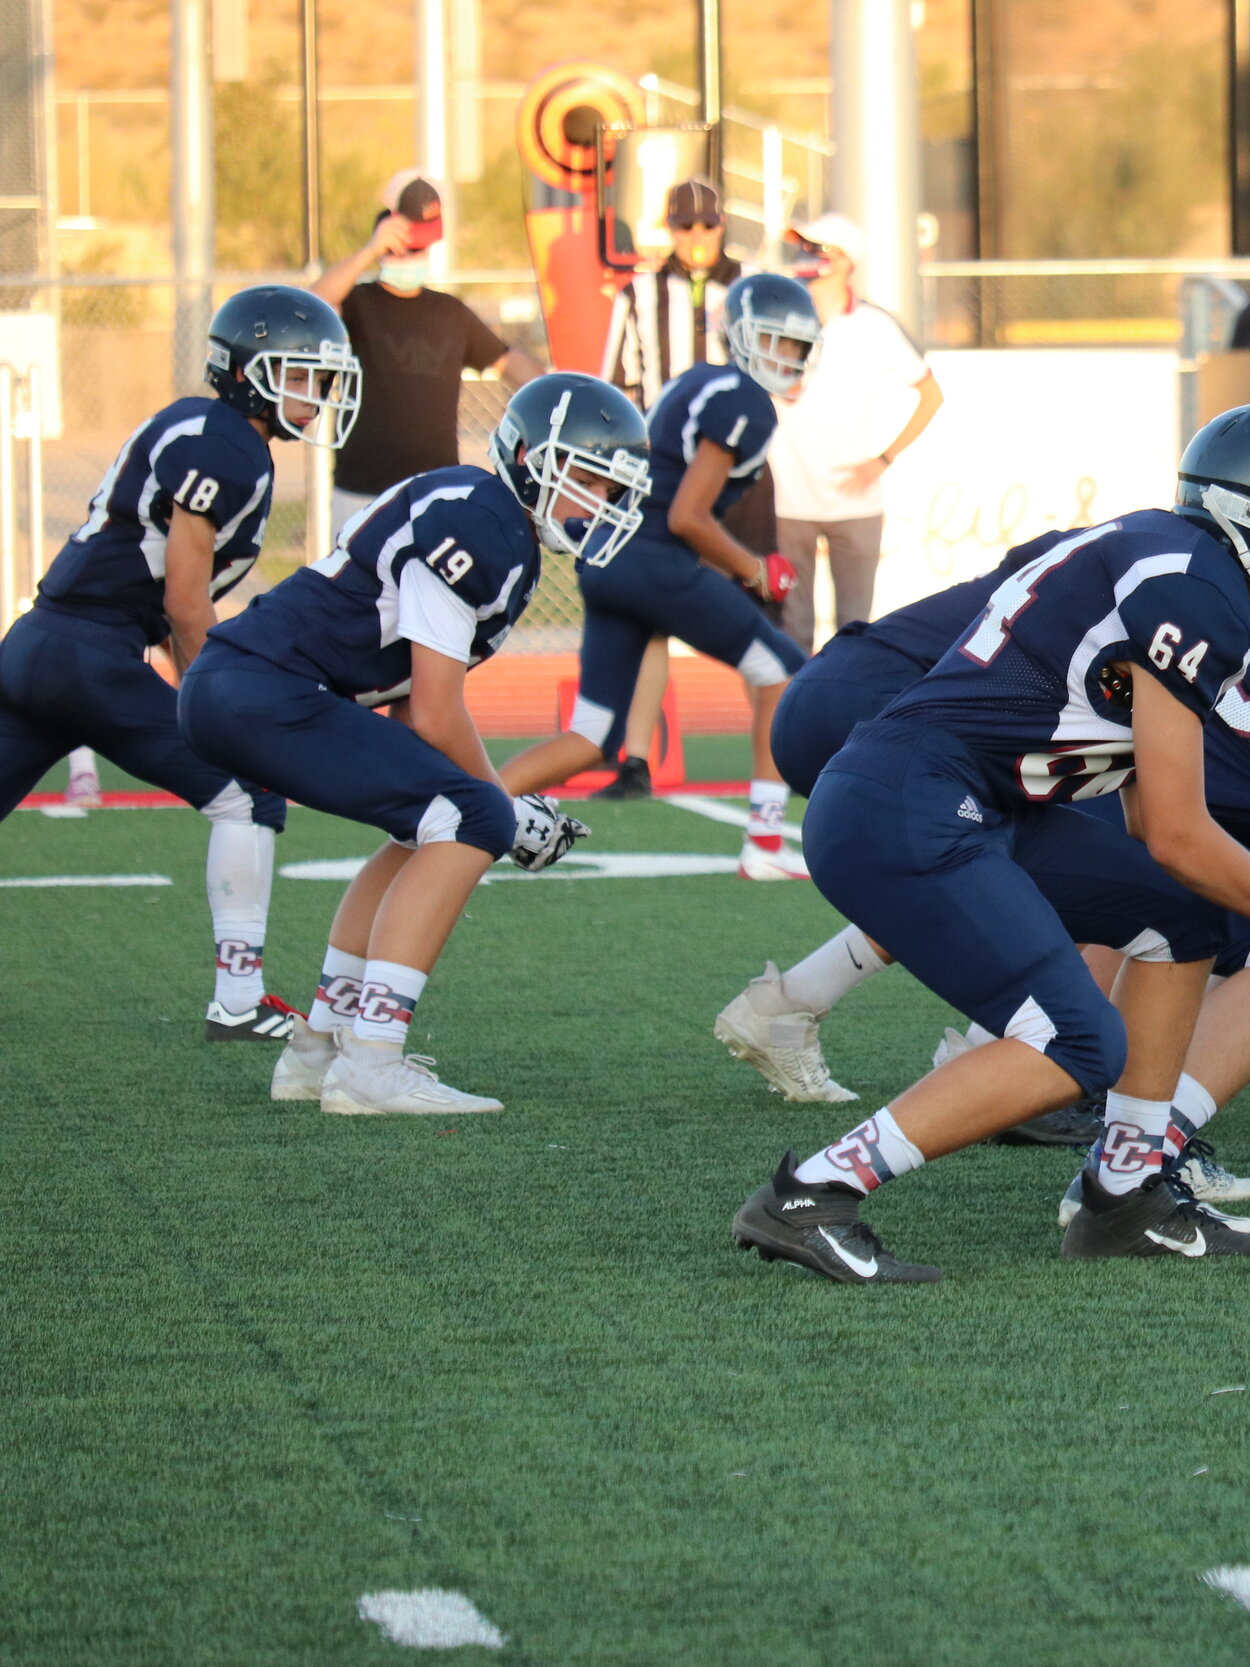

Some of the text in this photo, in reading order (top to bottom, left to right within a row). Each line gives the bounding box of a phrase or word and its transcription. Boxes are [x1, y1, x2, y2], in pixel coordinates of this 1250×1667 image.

[726, 415, 748, 447] 1
[174, 469, 219, 512] 18
[426, 537, 474, 586] 19
[1148, 621, 1210, 685] 64
[1102, 1120, 1152, 1173] CC
